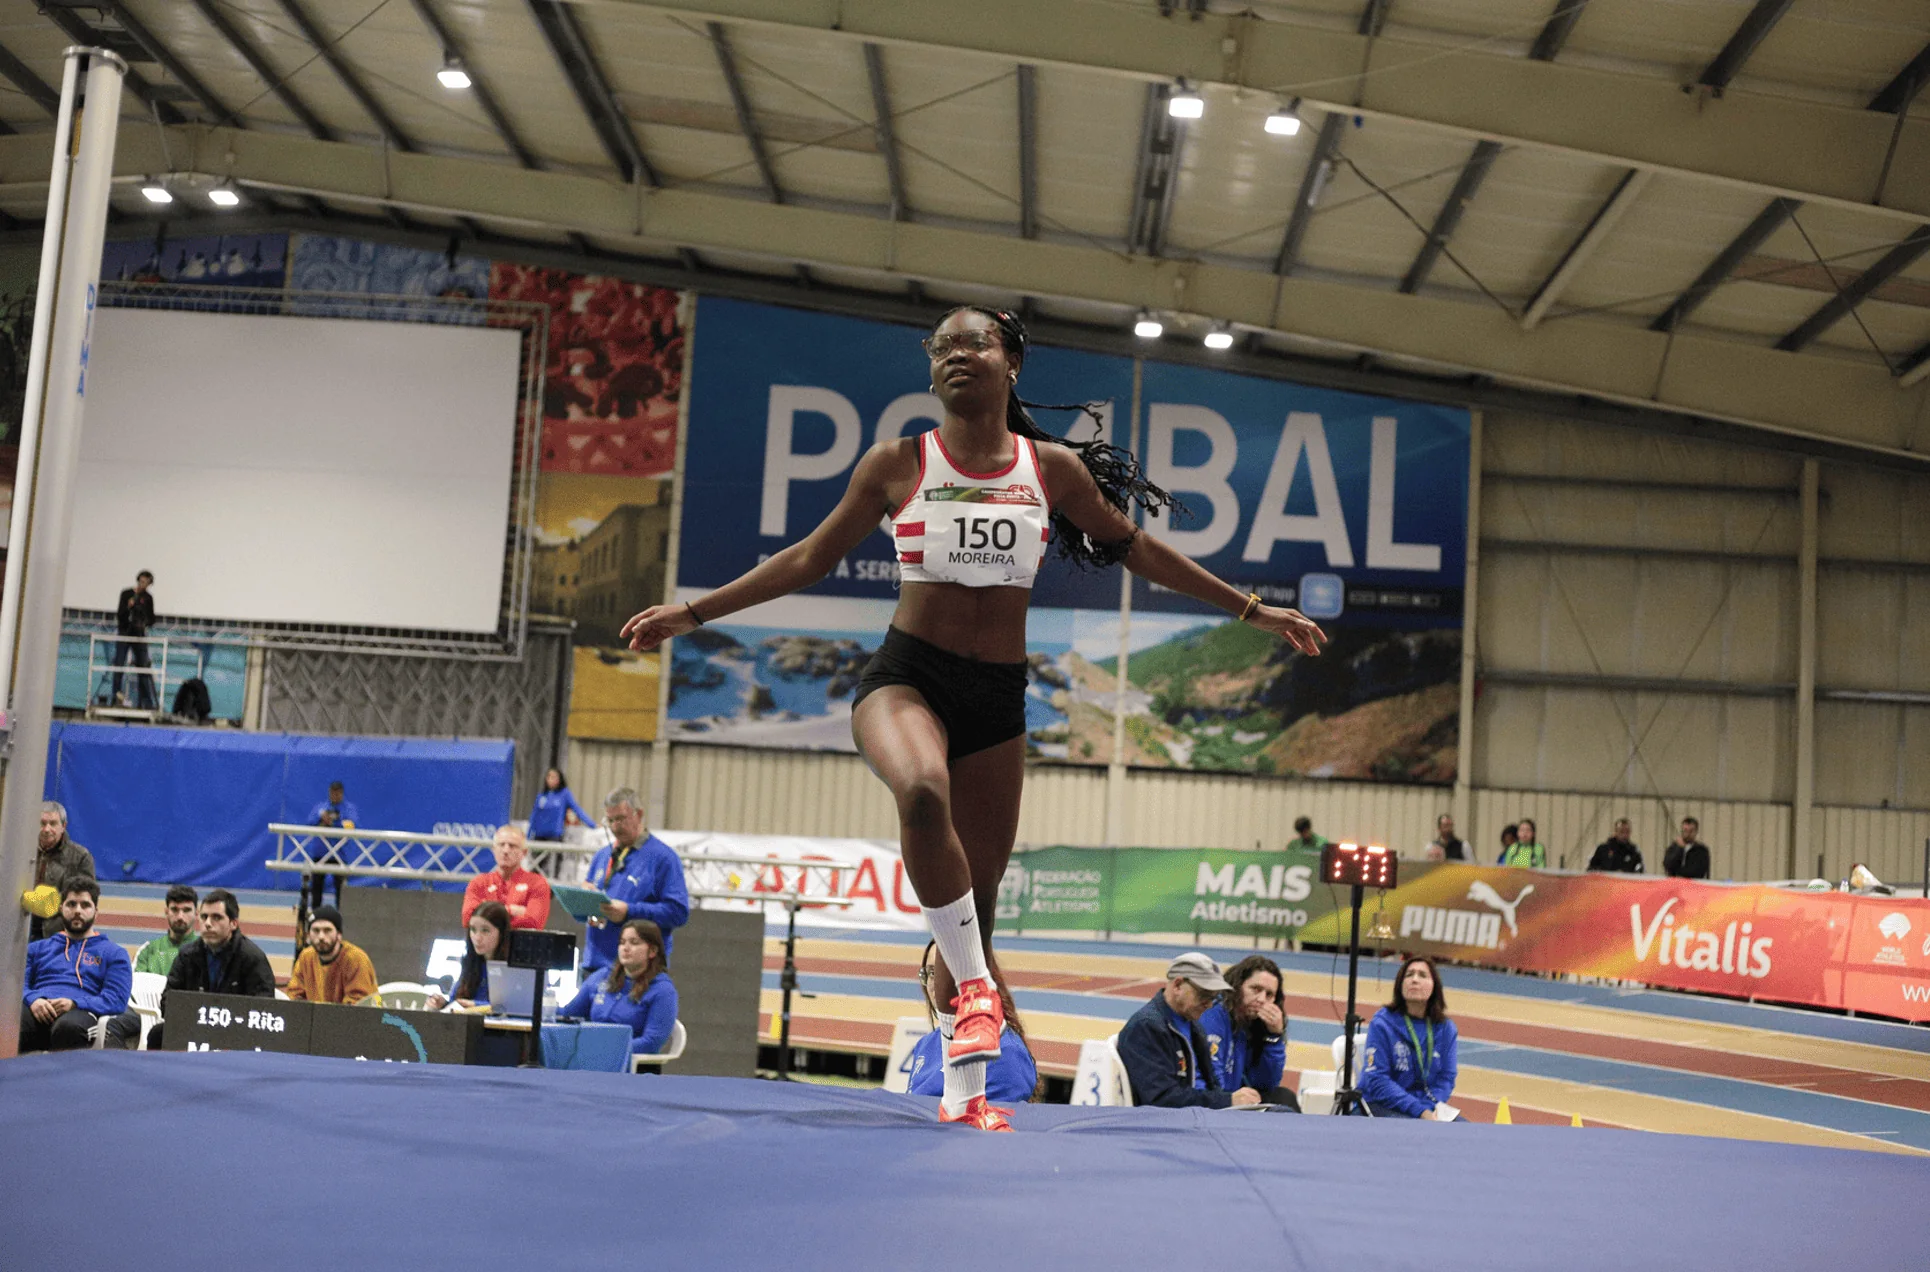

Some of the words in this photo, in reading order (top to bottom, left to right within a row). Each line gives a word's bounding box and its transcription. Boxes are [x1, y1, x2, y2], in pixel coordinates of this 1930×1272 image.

[953, 517, 1017, 551] 150
[948, 552, 1016, 566] MOREIRA
[1195, 861, 1313, 902] MAIS
[1190, 901, 1309, 927] Atletismo
[1400, 905, 1502, 949] PUMA
[1630, 896, 1773, 978] Vitalis
[197, 1006, 231, 1028] 150
[248, 1010, 285, 1033] Rita
